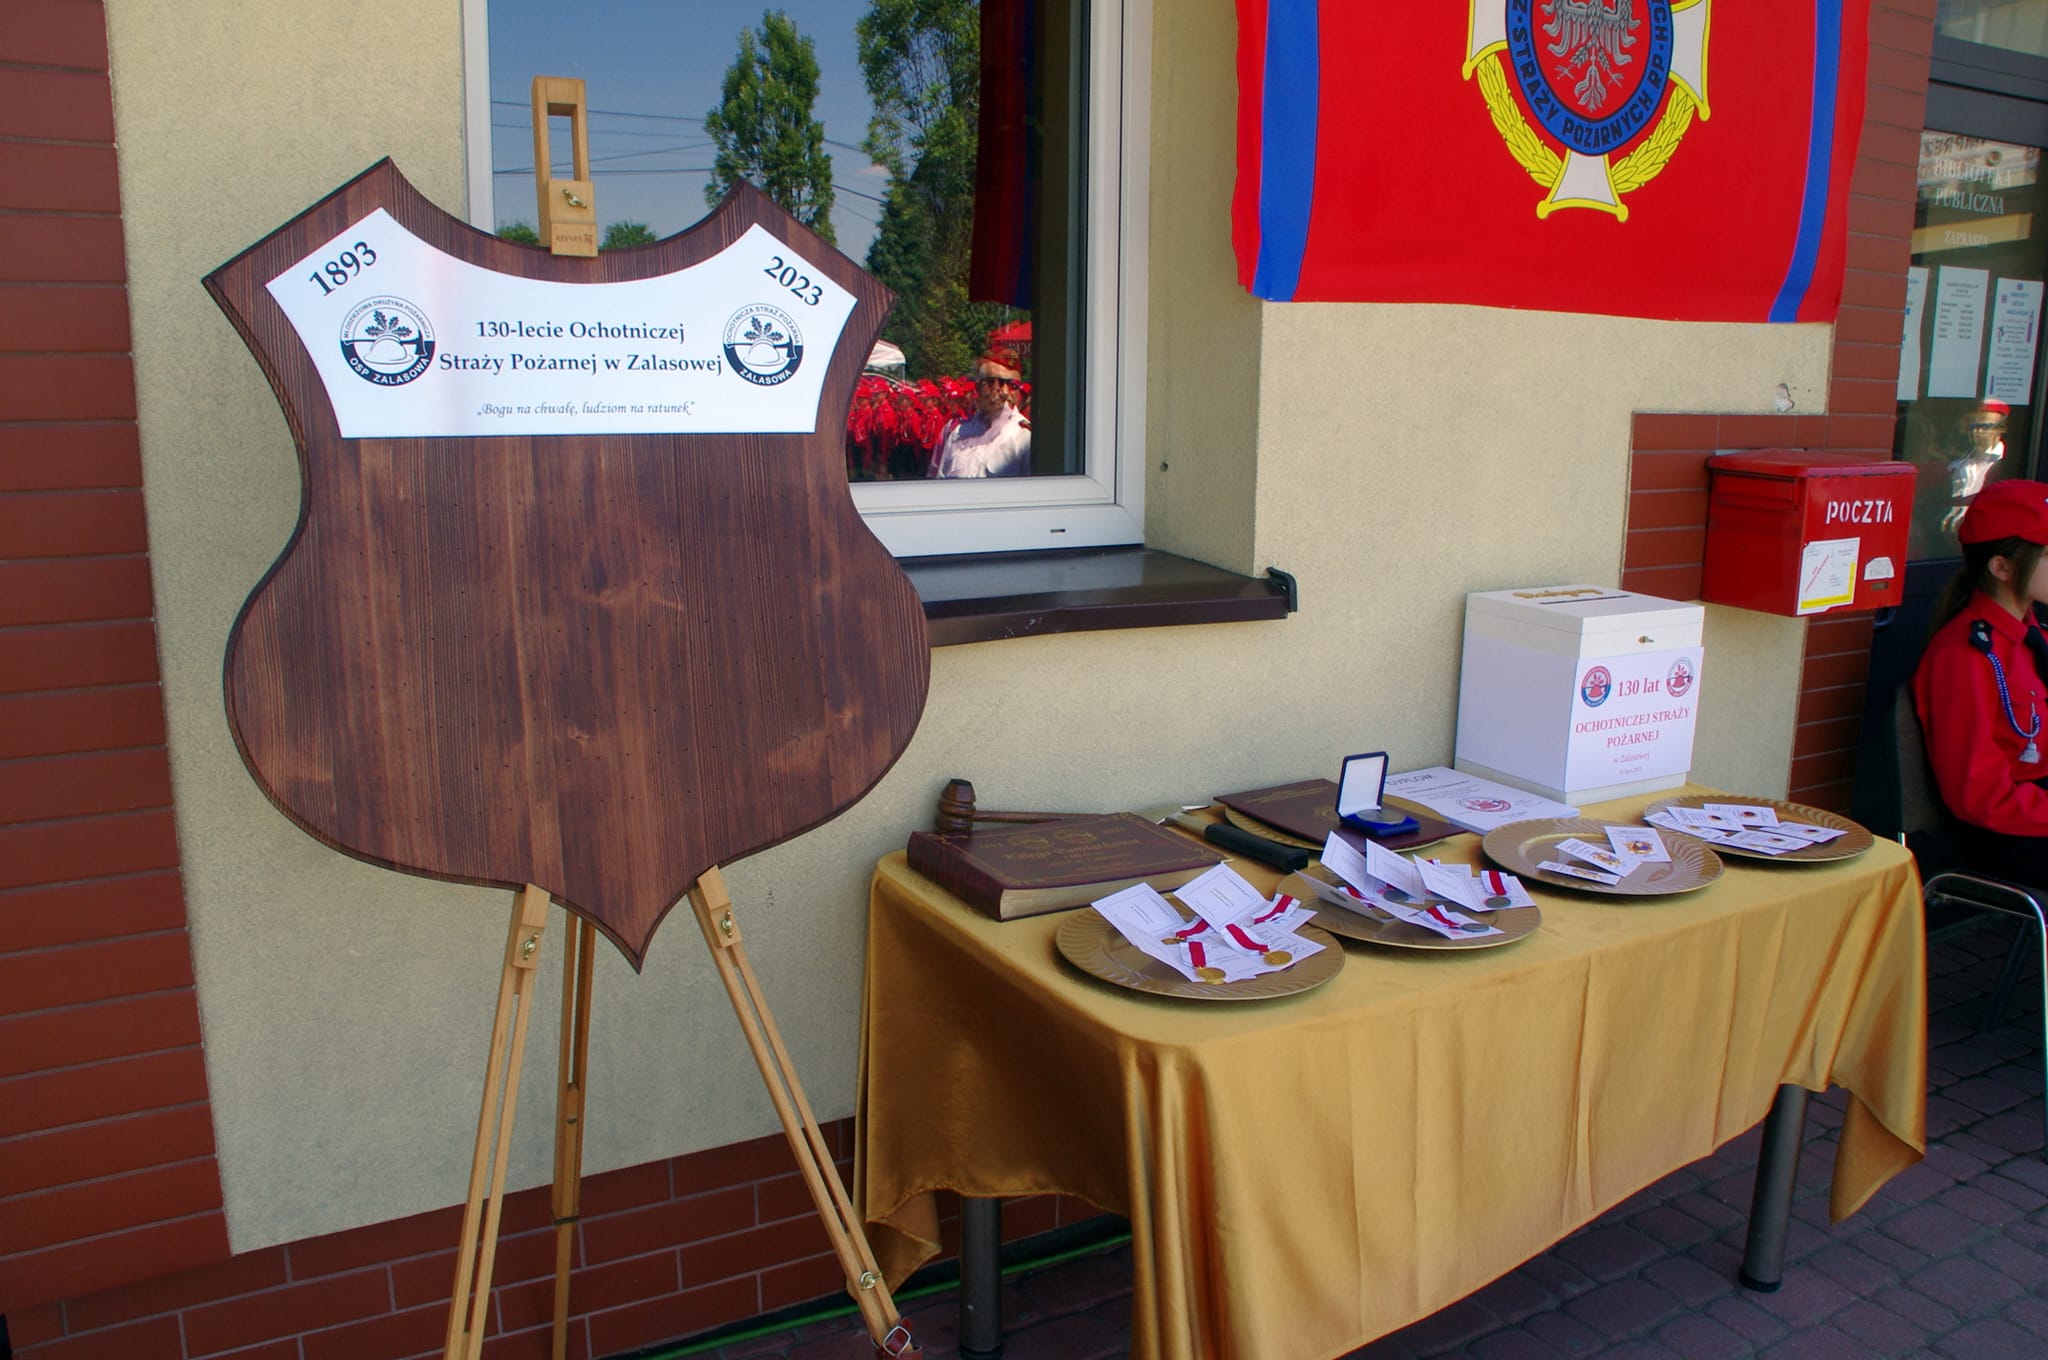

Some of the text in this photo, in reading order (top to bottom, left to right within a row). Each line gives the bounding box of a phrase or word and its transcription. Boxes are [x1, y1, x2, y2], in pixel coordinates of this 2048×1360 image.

[1511, 26, 1559, 120] STRAŻY
[1562, 92, 1655, 148] POŻARNYCH
[1935, 188, 2005, 214] PUBLICZNA
[1943, 231, 1988, 248] ZAPRASZA
[309, 241, 377, 297] 1893
[763, 255, 824, 306] 2023
[476, 320, 685, 344] 130-lecie Ochotniczej
[725, 306, 754, 343] OCHOTNICZA
[755, 305, 780, 317] STRAŻ
[349, 357, 430, 384] OSP ZALASOWA
[439, 352, 722, 376] Straży Pożarnej w Zalasowej
[740, 368, 792, 385] ZALASOWA
[516, 404, 531, 415] na
[534, 401, 578, 416] chwałę,
[582, 401, 627, 414] ludziom
[631, 404, 644, 414] na
[1826, 501, 1892, 524] POCZTA
[1617, 680, 1640, 697] 130
[1643, 677, 1660, 694] lat
[1576, 707, 1689, 732] OCHOTNICZEJ STRAŻY
[1607, 731, 1659, 747] POŻARNEJ
